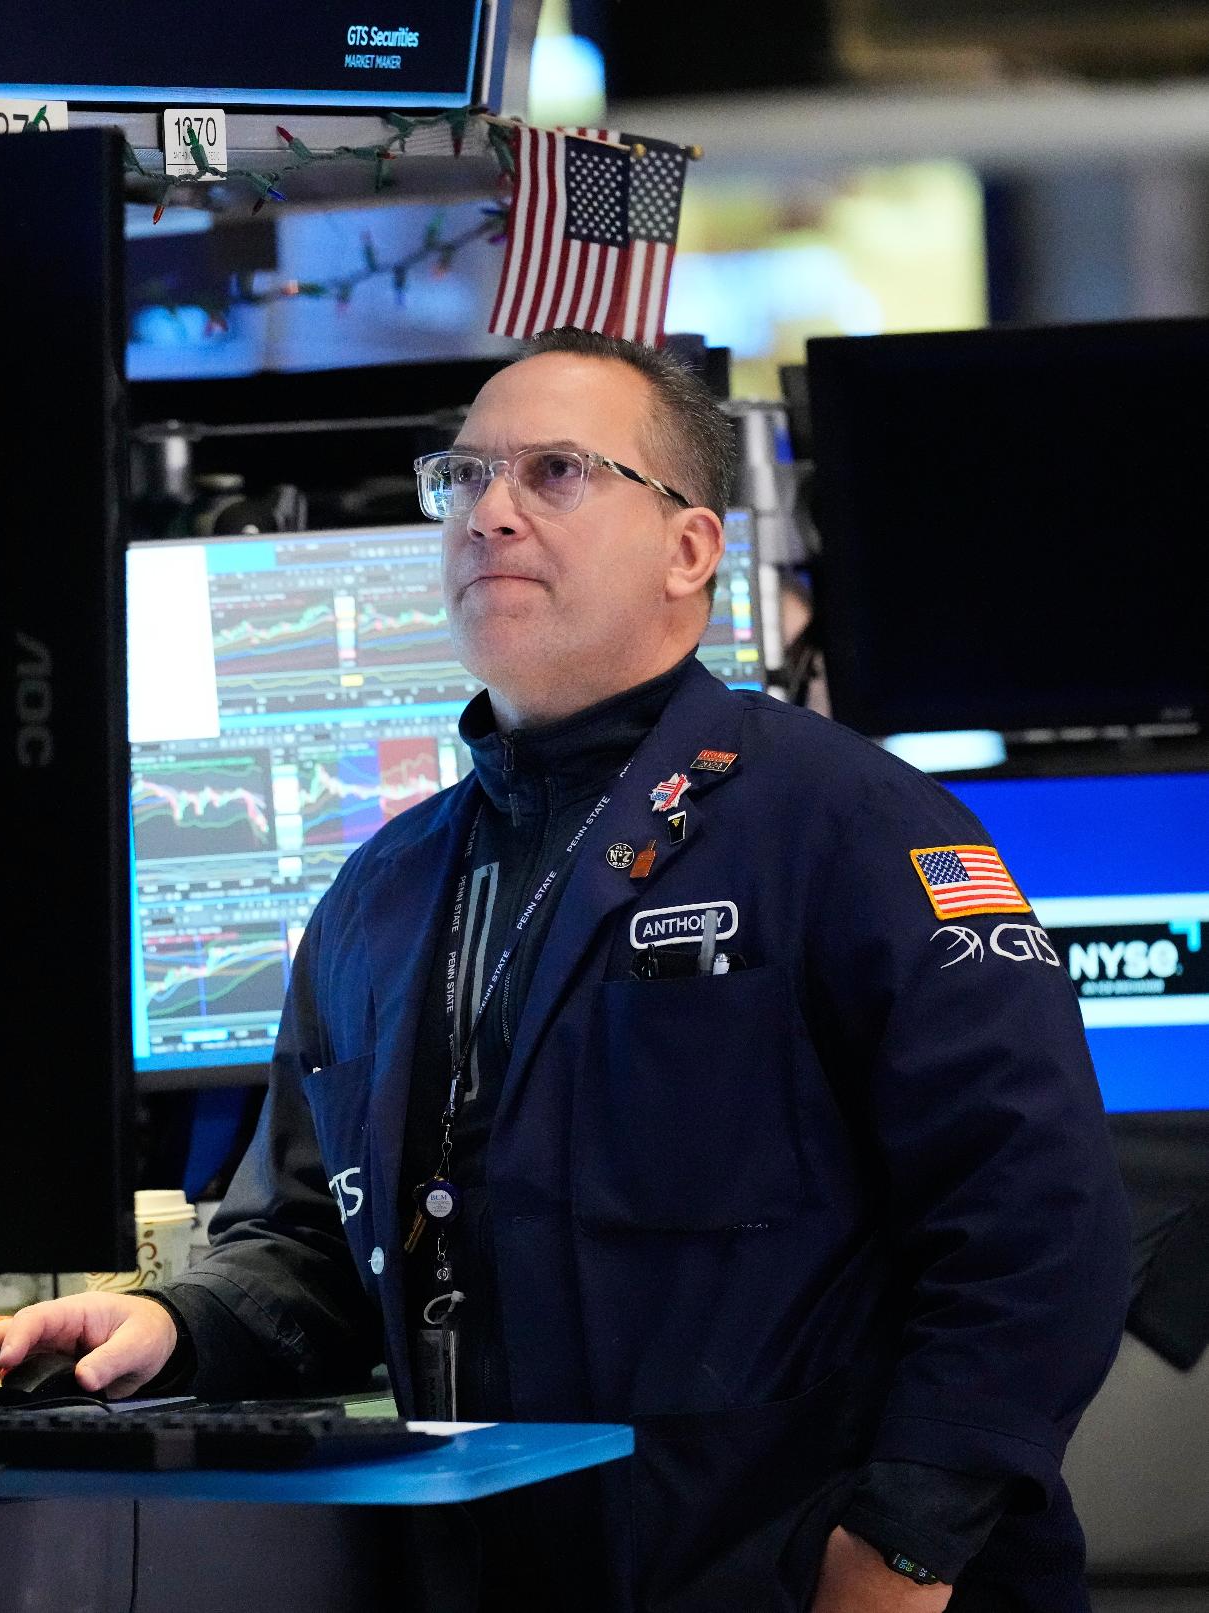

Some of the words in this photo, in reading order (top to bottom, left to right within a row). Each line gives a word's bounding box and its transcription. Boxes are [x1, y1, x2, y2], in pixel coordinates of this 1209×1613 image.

[346, 25, 369, 47] GTS
[369, 26, 420, 48] Securities
[343, 53, 375, 69] MARKET
[375, 54, 402, 70] MAKER
[566, 824, 588, 853] PENN
[585, 794, 611, 826] STATE
[454, 874, 467, 904] PENN
[516, 900, 538, 930] PENN
[534, 869, 558, 902] STATE
[451, 903, 462, 934] STATE
[989, 922, 1061, 967] GTS
[446, 951, 457, 980] PENN
[491, 948, 511, 984] STATE
[446, 981, 456, 1015] STATE
[328, 1166, 365, 1226] TS
